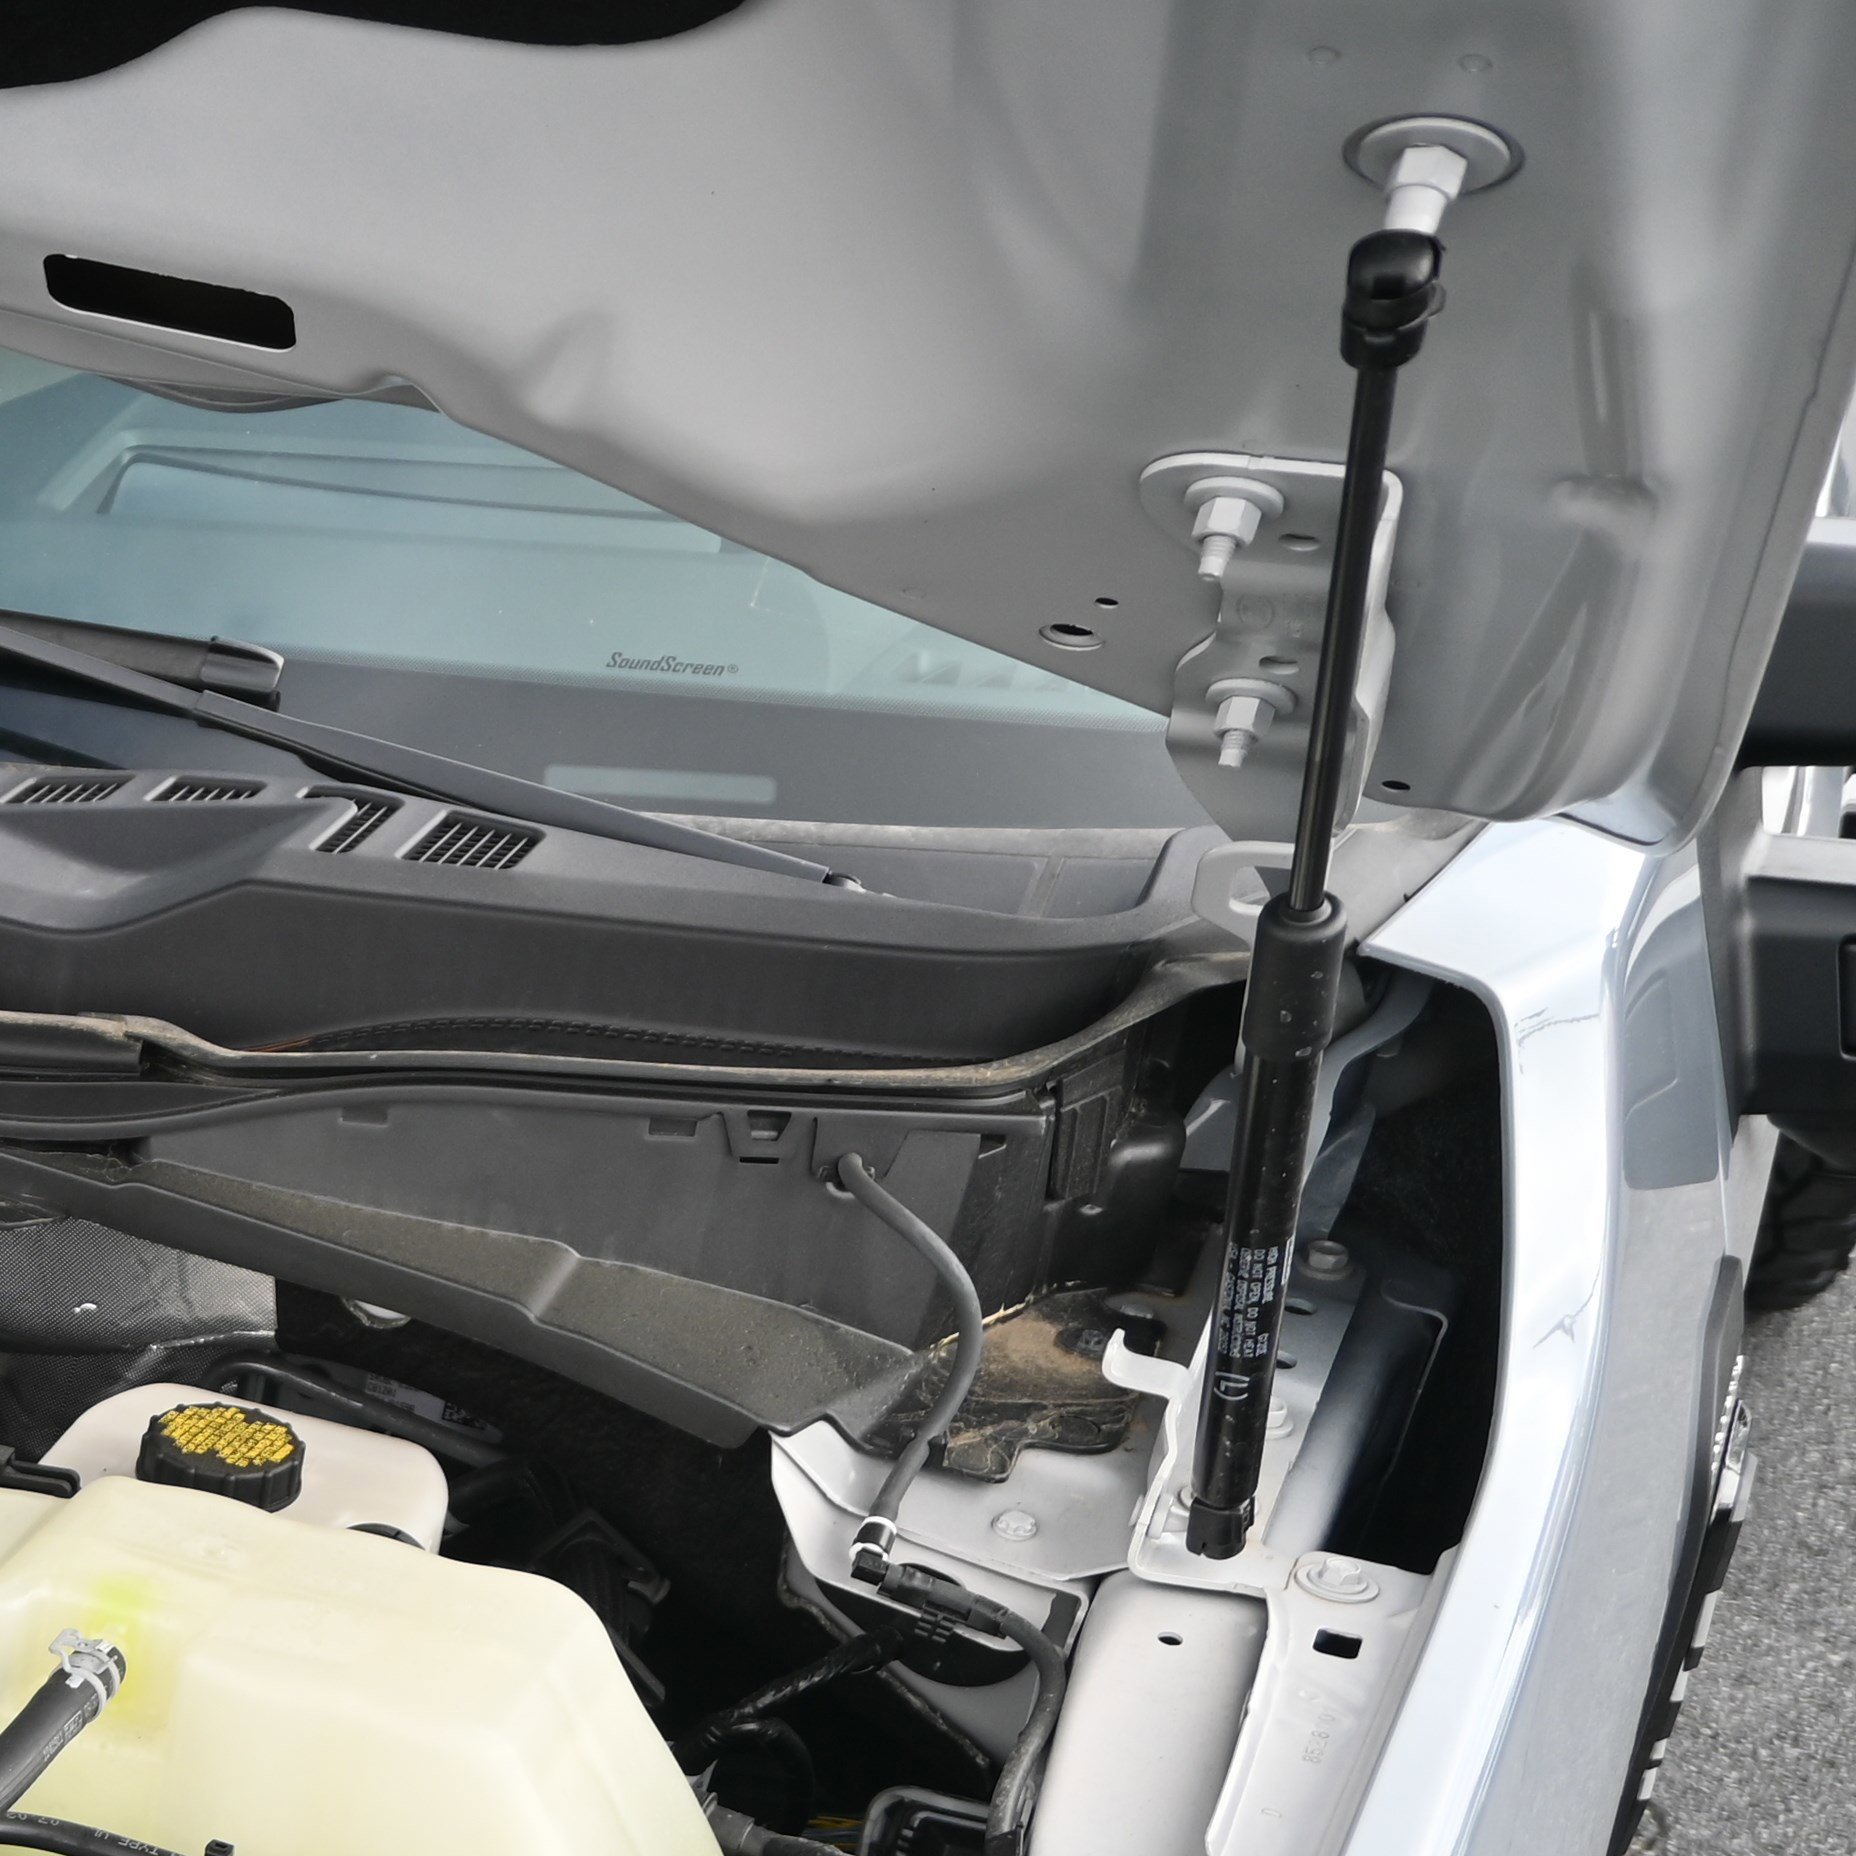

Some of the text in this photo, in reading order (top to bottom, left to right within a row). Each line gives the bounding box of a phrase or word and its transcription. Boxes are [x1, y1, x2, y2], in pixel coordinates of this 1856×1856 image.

[1254, 1249, 1265, 1260] DO
[1252, 1263, 1263, 1279] NOT
[1247, 1307, 1258, 1318] DO
[1245, 1321, 1256, 1336] NOT
